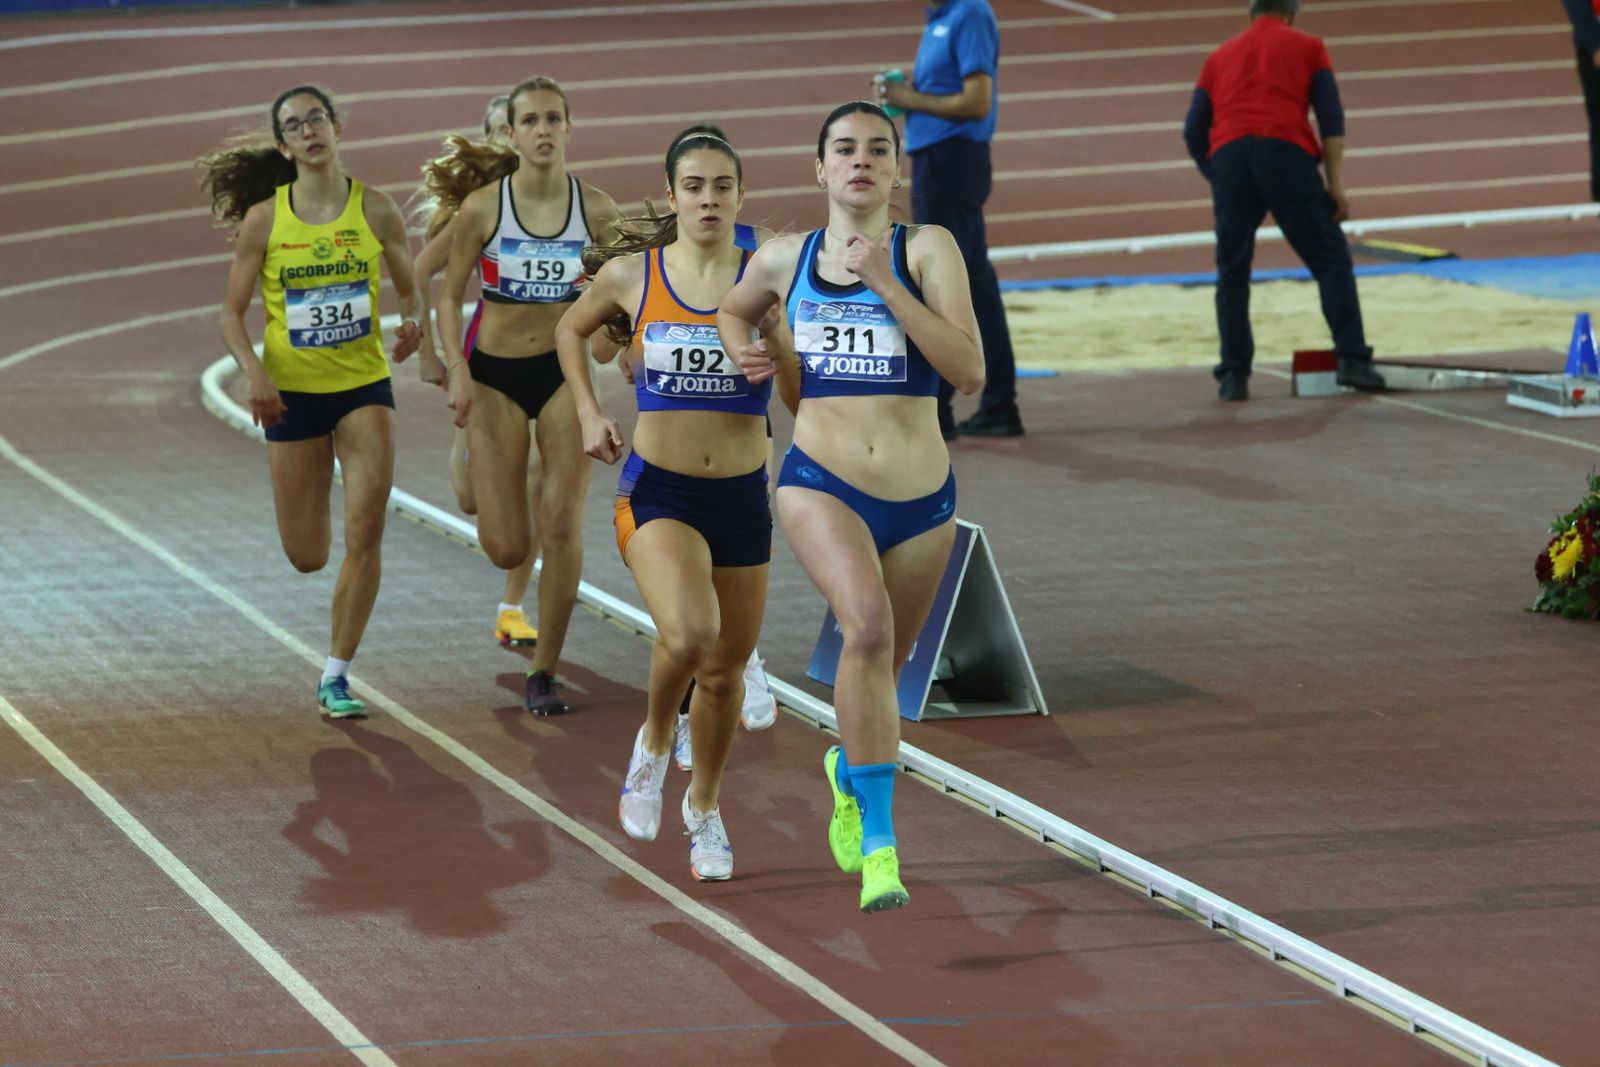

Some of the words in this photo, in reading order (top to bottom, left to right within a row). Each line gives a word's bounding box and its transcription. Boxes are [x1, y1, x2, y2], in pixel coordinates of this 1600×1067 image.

[287, 261, 368, 279] SCORPIO-71
[522, 260, 565, 281] 159
[309, 302, 354, 327] 334
[822, 326, 874, 354] 311
[671, 347, 725, 374] 192
